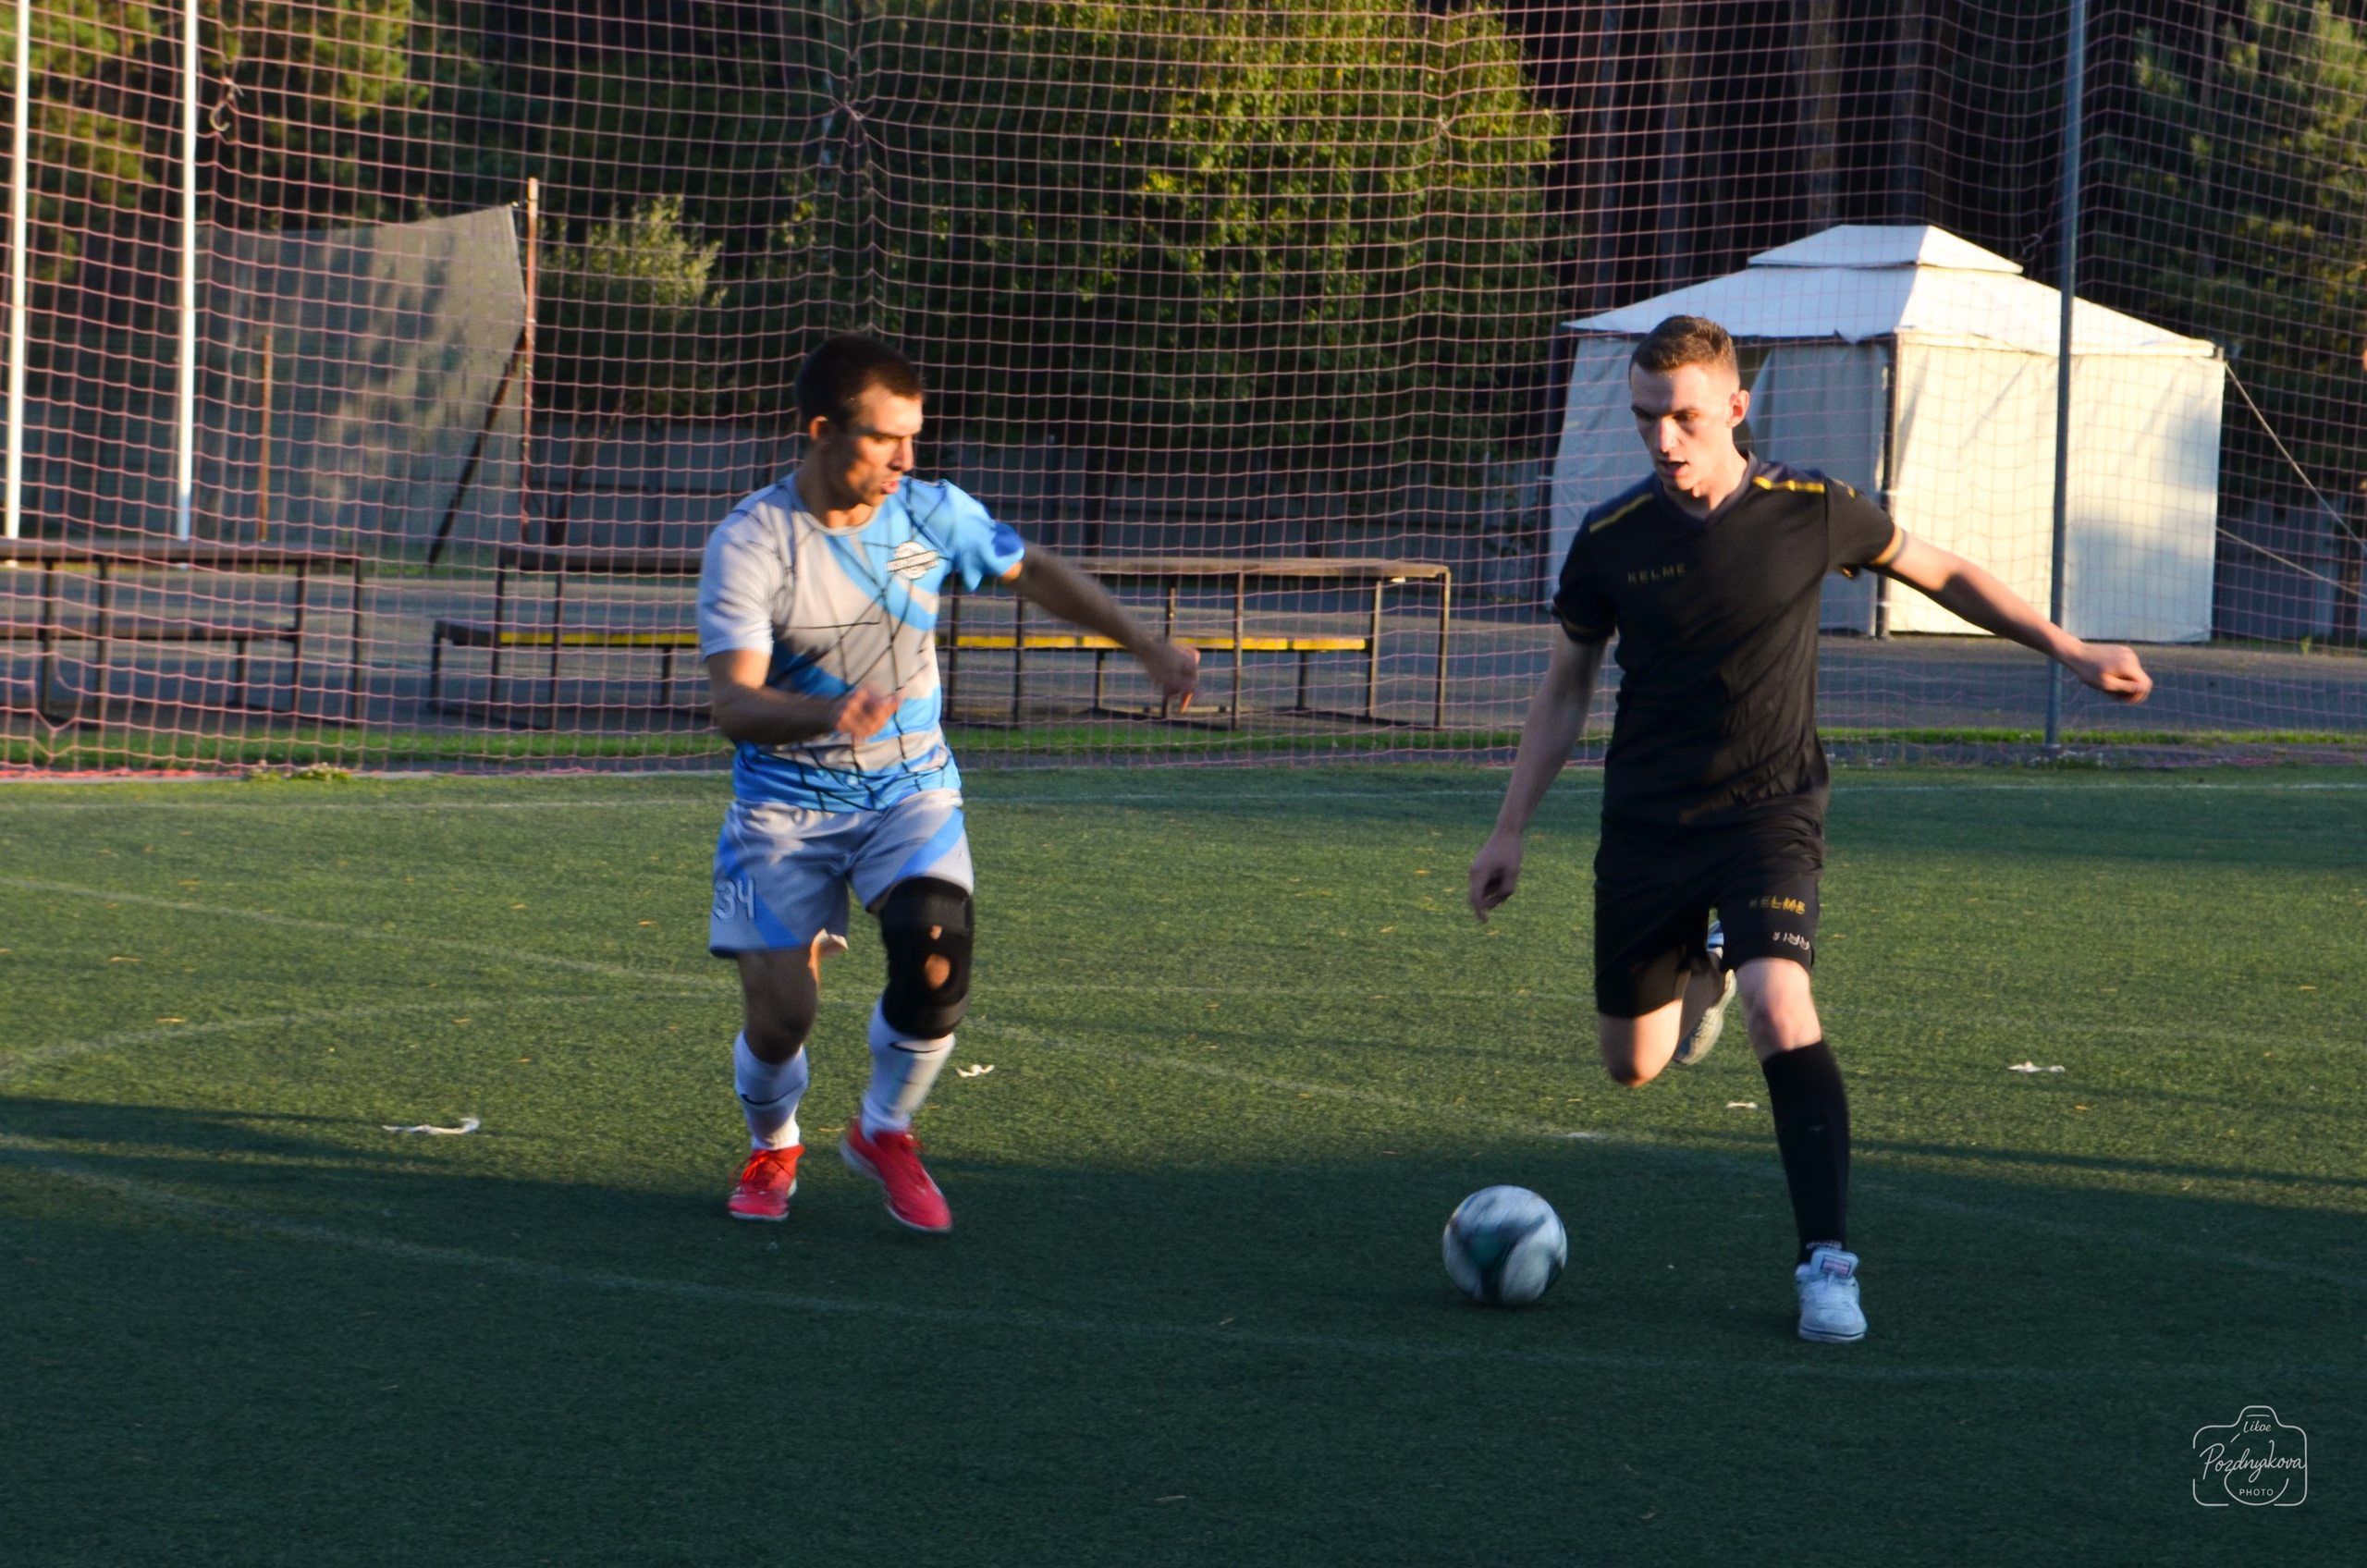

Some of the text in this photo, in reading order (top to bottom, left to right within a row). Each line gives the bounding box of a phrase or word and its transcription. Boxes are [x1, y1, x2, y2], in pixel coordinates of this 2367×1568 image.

[1627, 562, 1686, 586] KELME
[713, 879, 756, 920] 34
[1748, 895, 1806, 915] KELME
